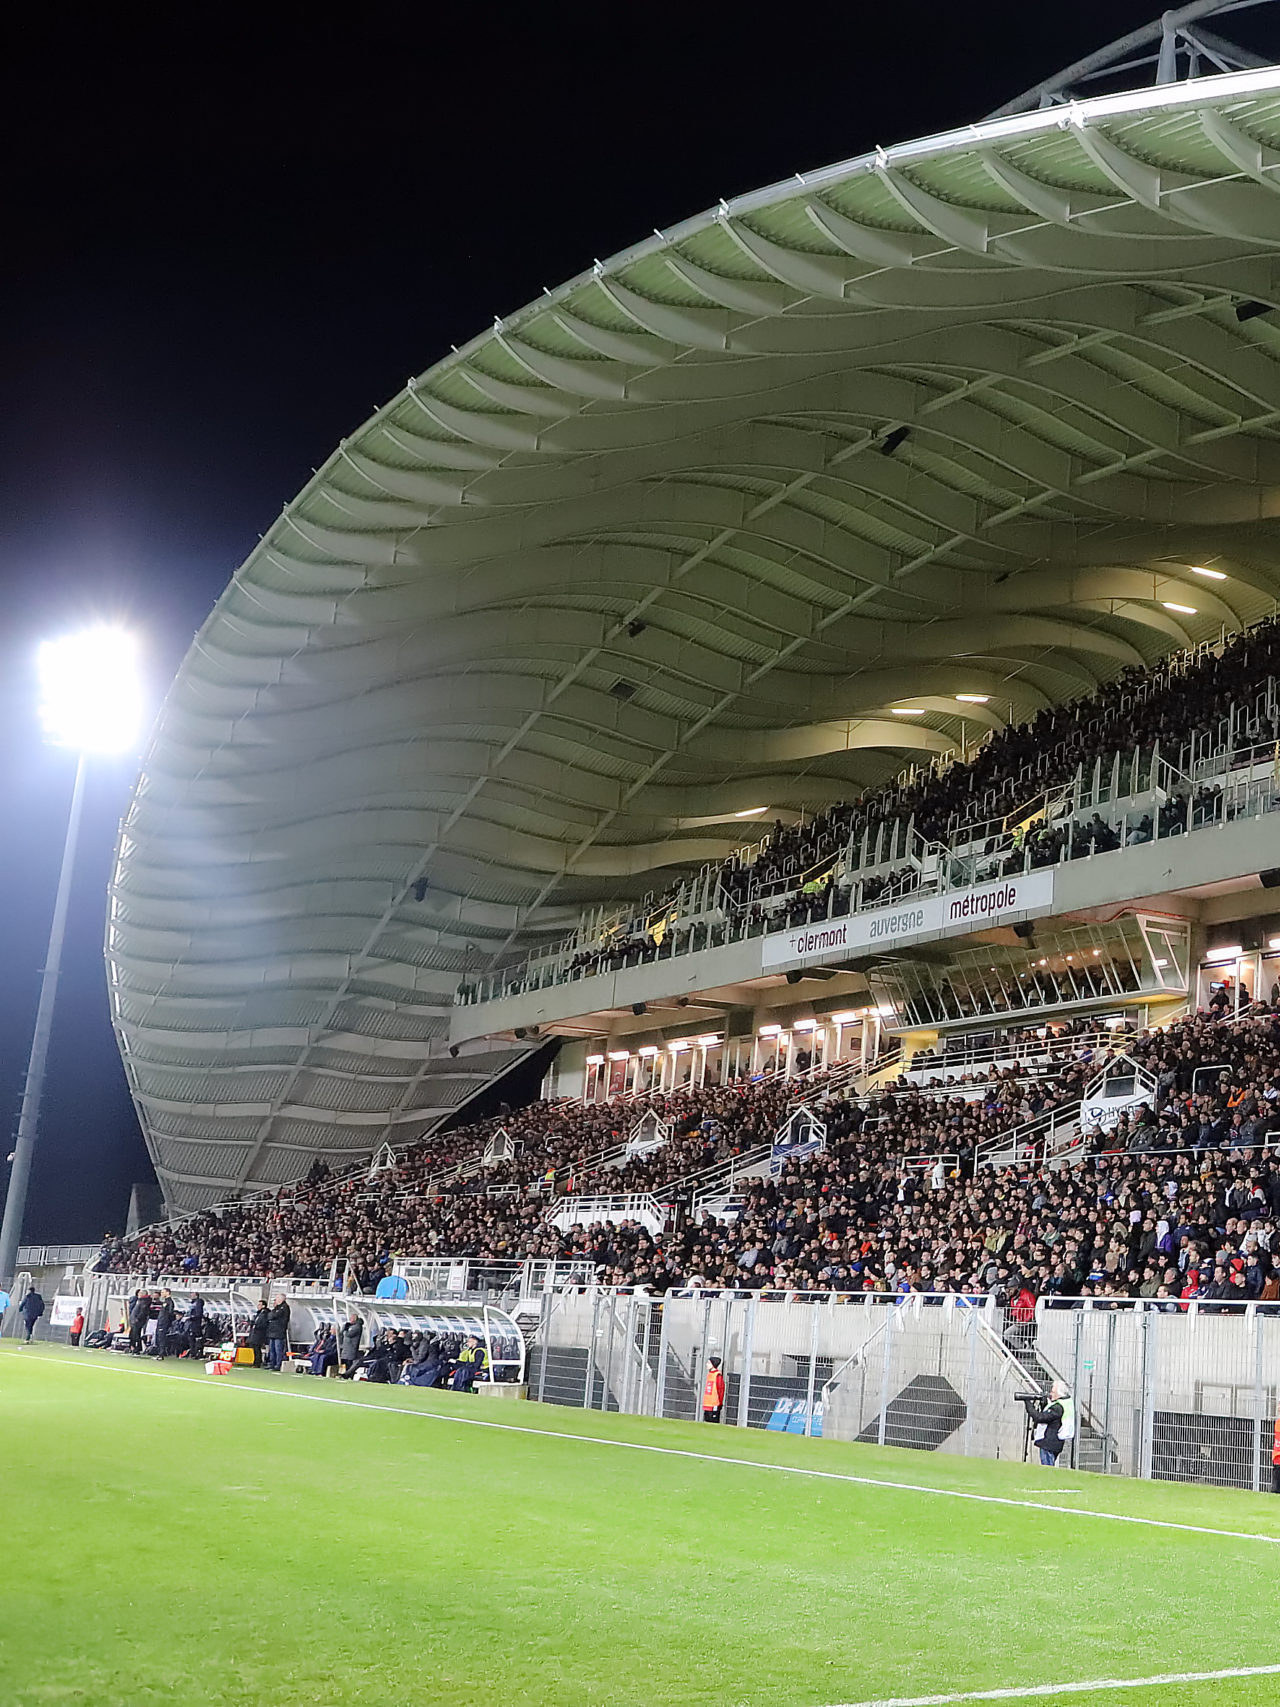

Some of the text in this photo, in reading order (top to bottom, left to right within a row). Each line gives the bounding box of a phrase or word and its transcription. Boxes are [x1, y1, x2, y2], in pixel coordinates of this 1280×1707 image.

[797, 883, 1016, 954] clermont auvergne métropole
